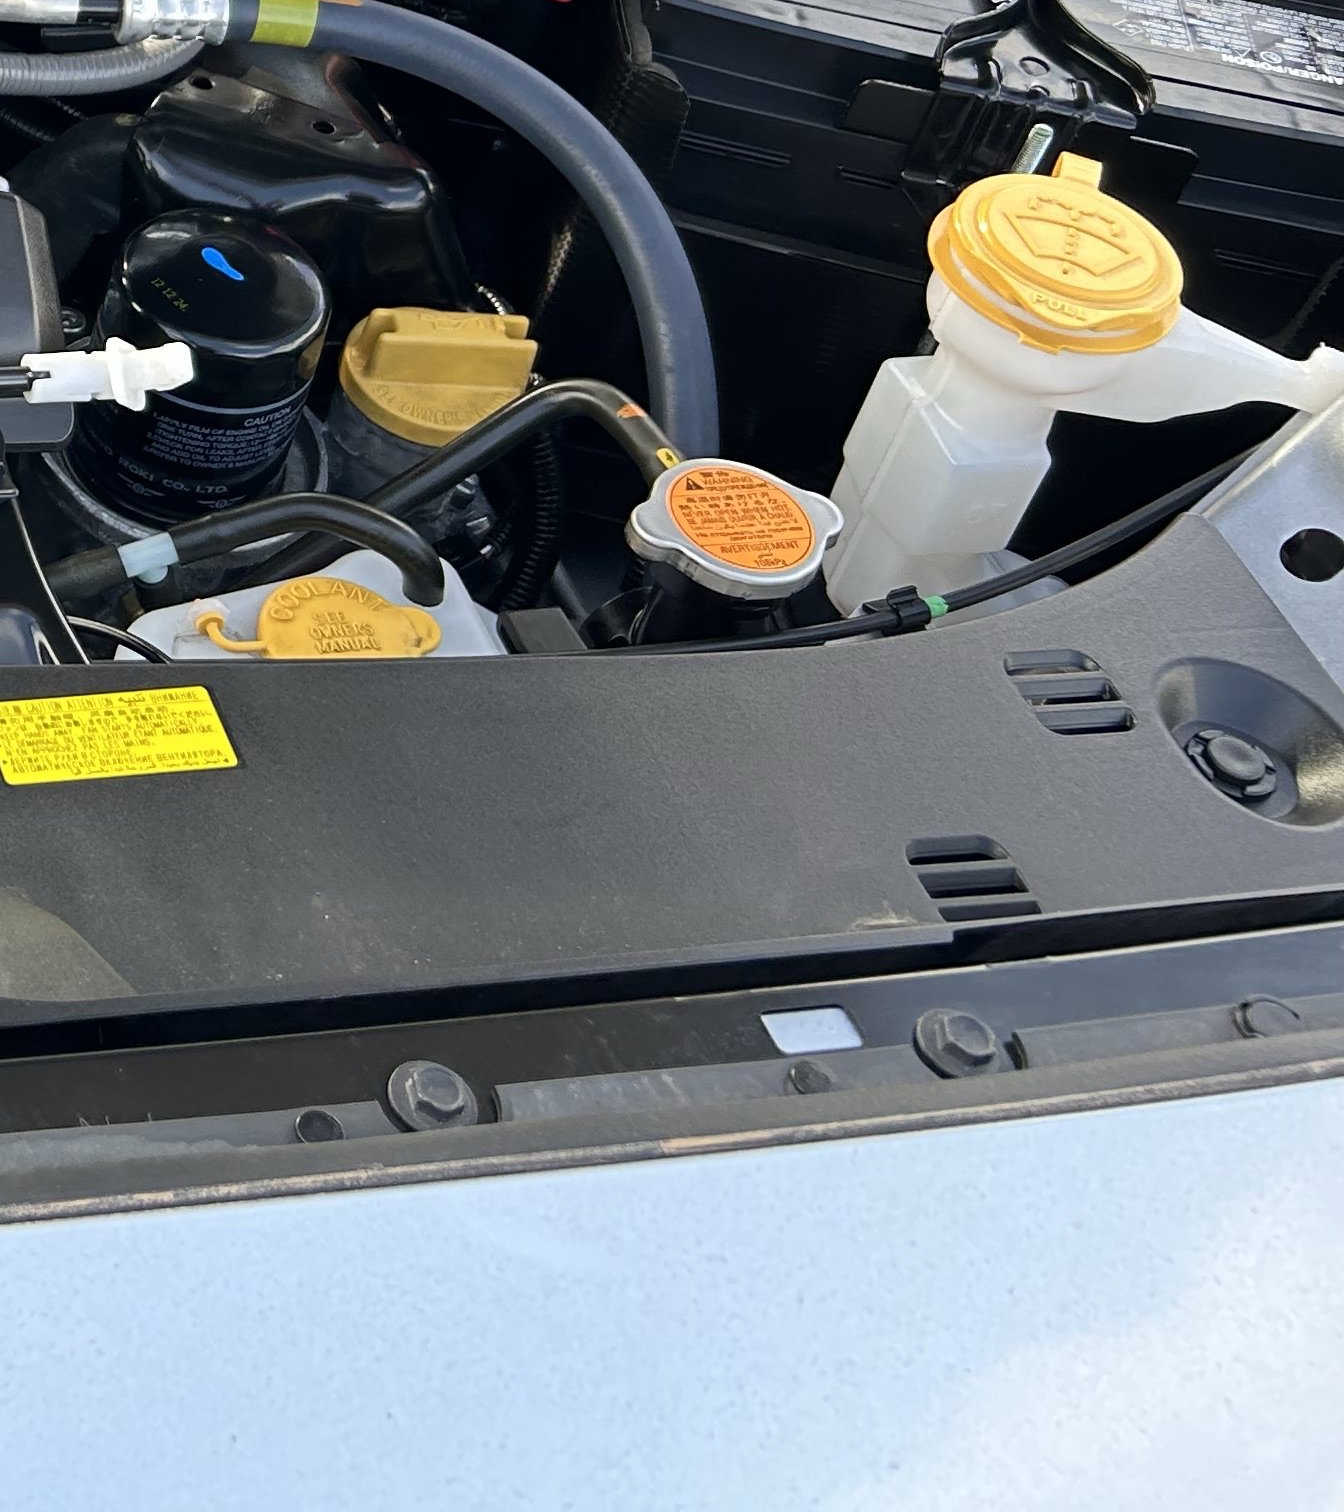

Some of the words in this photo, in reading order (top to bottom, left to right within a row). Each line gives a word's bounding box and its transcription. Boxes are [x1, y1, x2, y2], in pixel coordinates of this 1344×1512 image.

[244, 405, 292, 427] CAUTION
[270, 581, 389, 621] COOLANT
[314, 636, 381, 654] MANUAL
[25, 702, 62, 713] CAUTION
